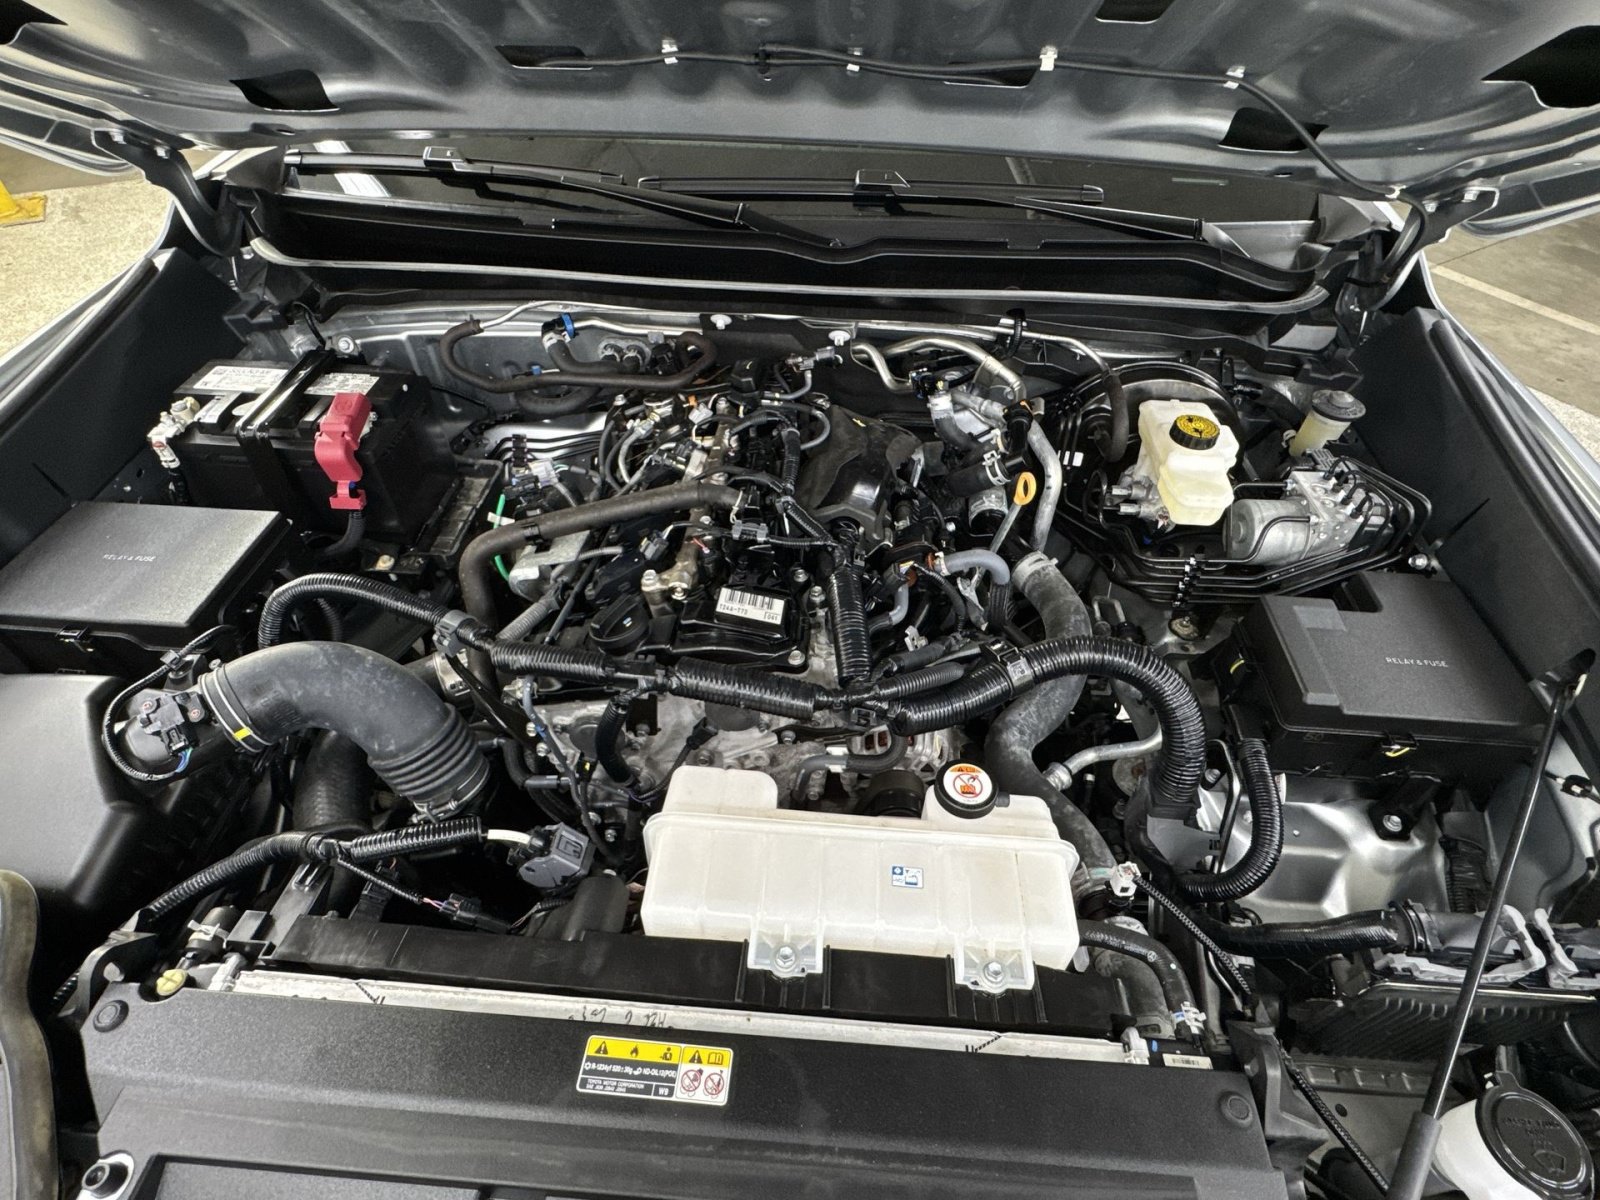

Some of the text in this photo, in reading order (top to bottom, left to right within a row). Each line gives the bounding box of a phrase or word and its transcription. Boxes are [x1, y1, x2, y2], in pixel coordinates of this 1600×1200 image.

[1385, 657, 1414, 665] RELAY
[1423, 659, 1448, 668] FUSE
[617, 1081, 645, 1089] CORPORATION
